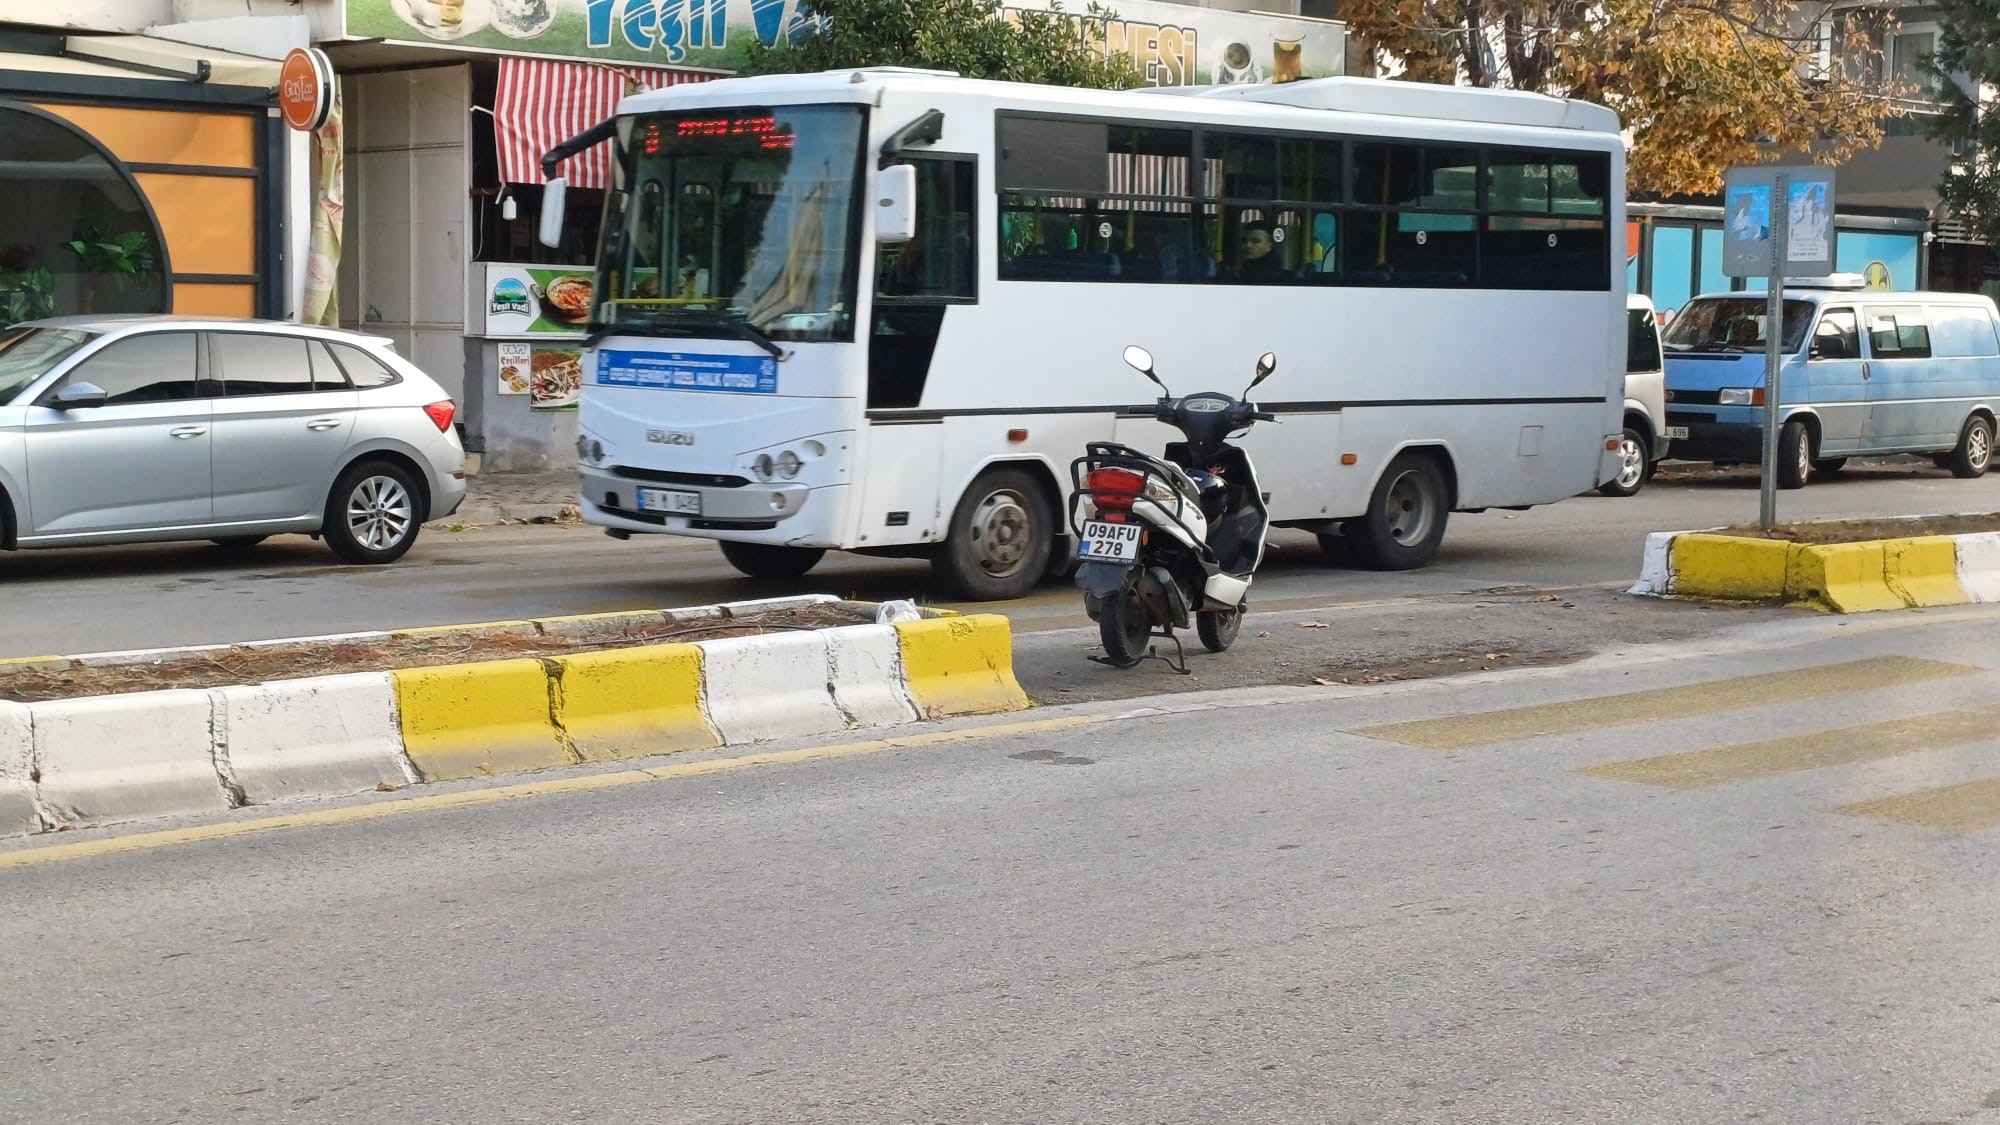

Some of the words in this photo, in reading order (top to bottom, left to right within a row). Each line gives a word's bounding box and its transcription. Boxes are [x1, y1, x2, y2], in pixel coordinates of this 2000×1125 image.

[646, 428, 696, 446] ISUZU
[1088, 523, 1137, 541] 09AFU
[1093, 540, 1123, 556] 278
